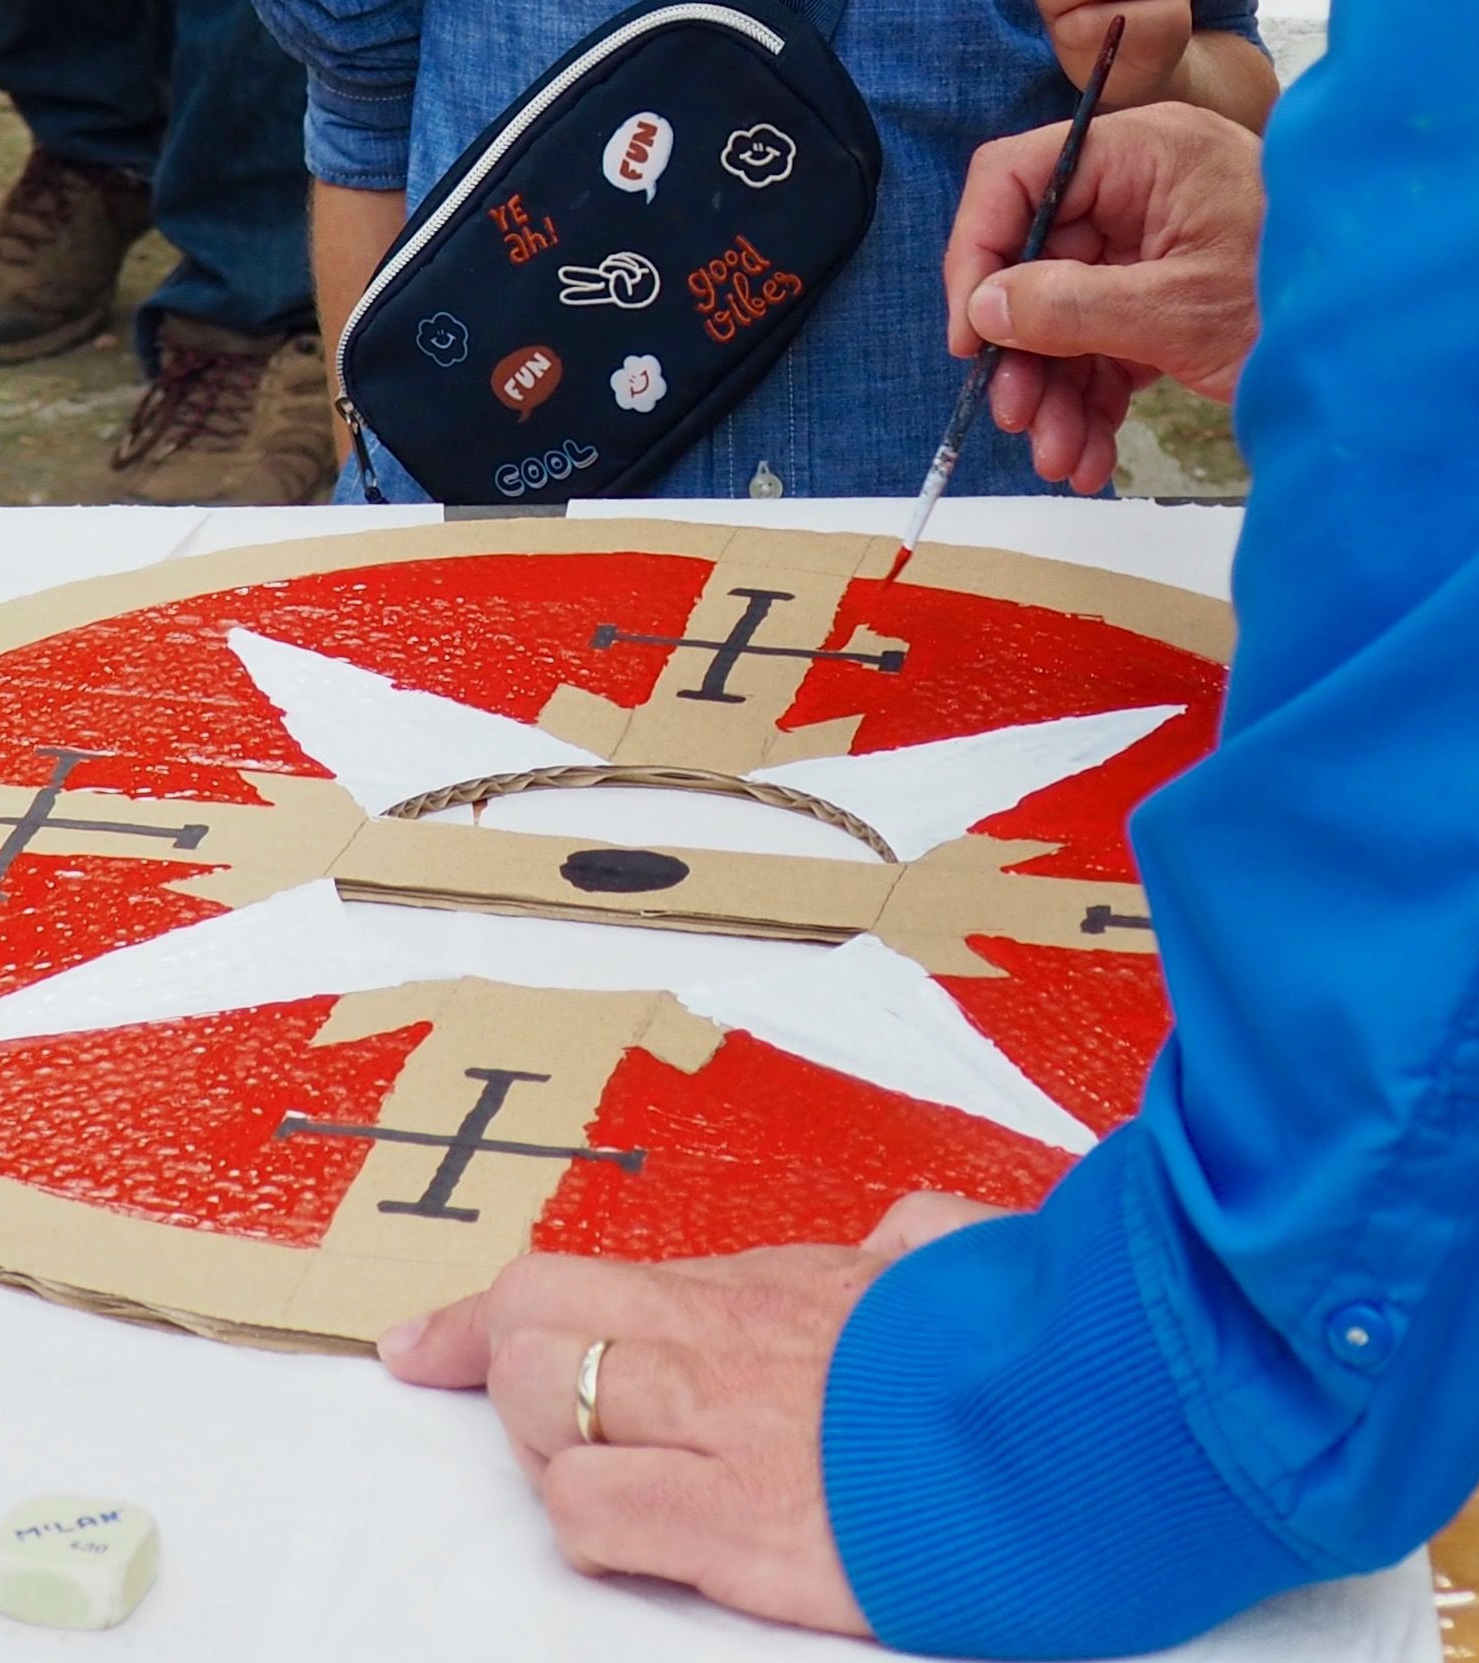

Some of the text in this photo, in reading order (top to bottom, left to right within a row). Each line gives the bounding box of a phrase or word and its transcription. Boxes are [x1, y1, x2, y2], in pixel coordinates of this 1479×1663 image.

[620, 121, 658, 181] FUN
[489, 194, 528, 232] YE
[687, 235, 770, 312] good
[705, 271, 802, 341] vibes
[504, 352, 552, 401] FUN
[495, 439, 599, 497] COOL
